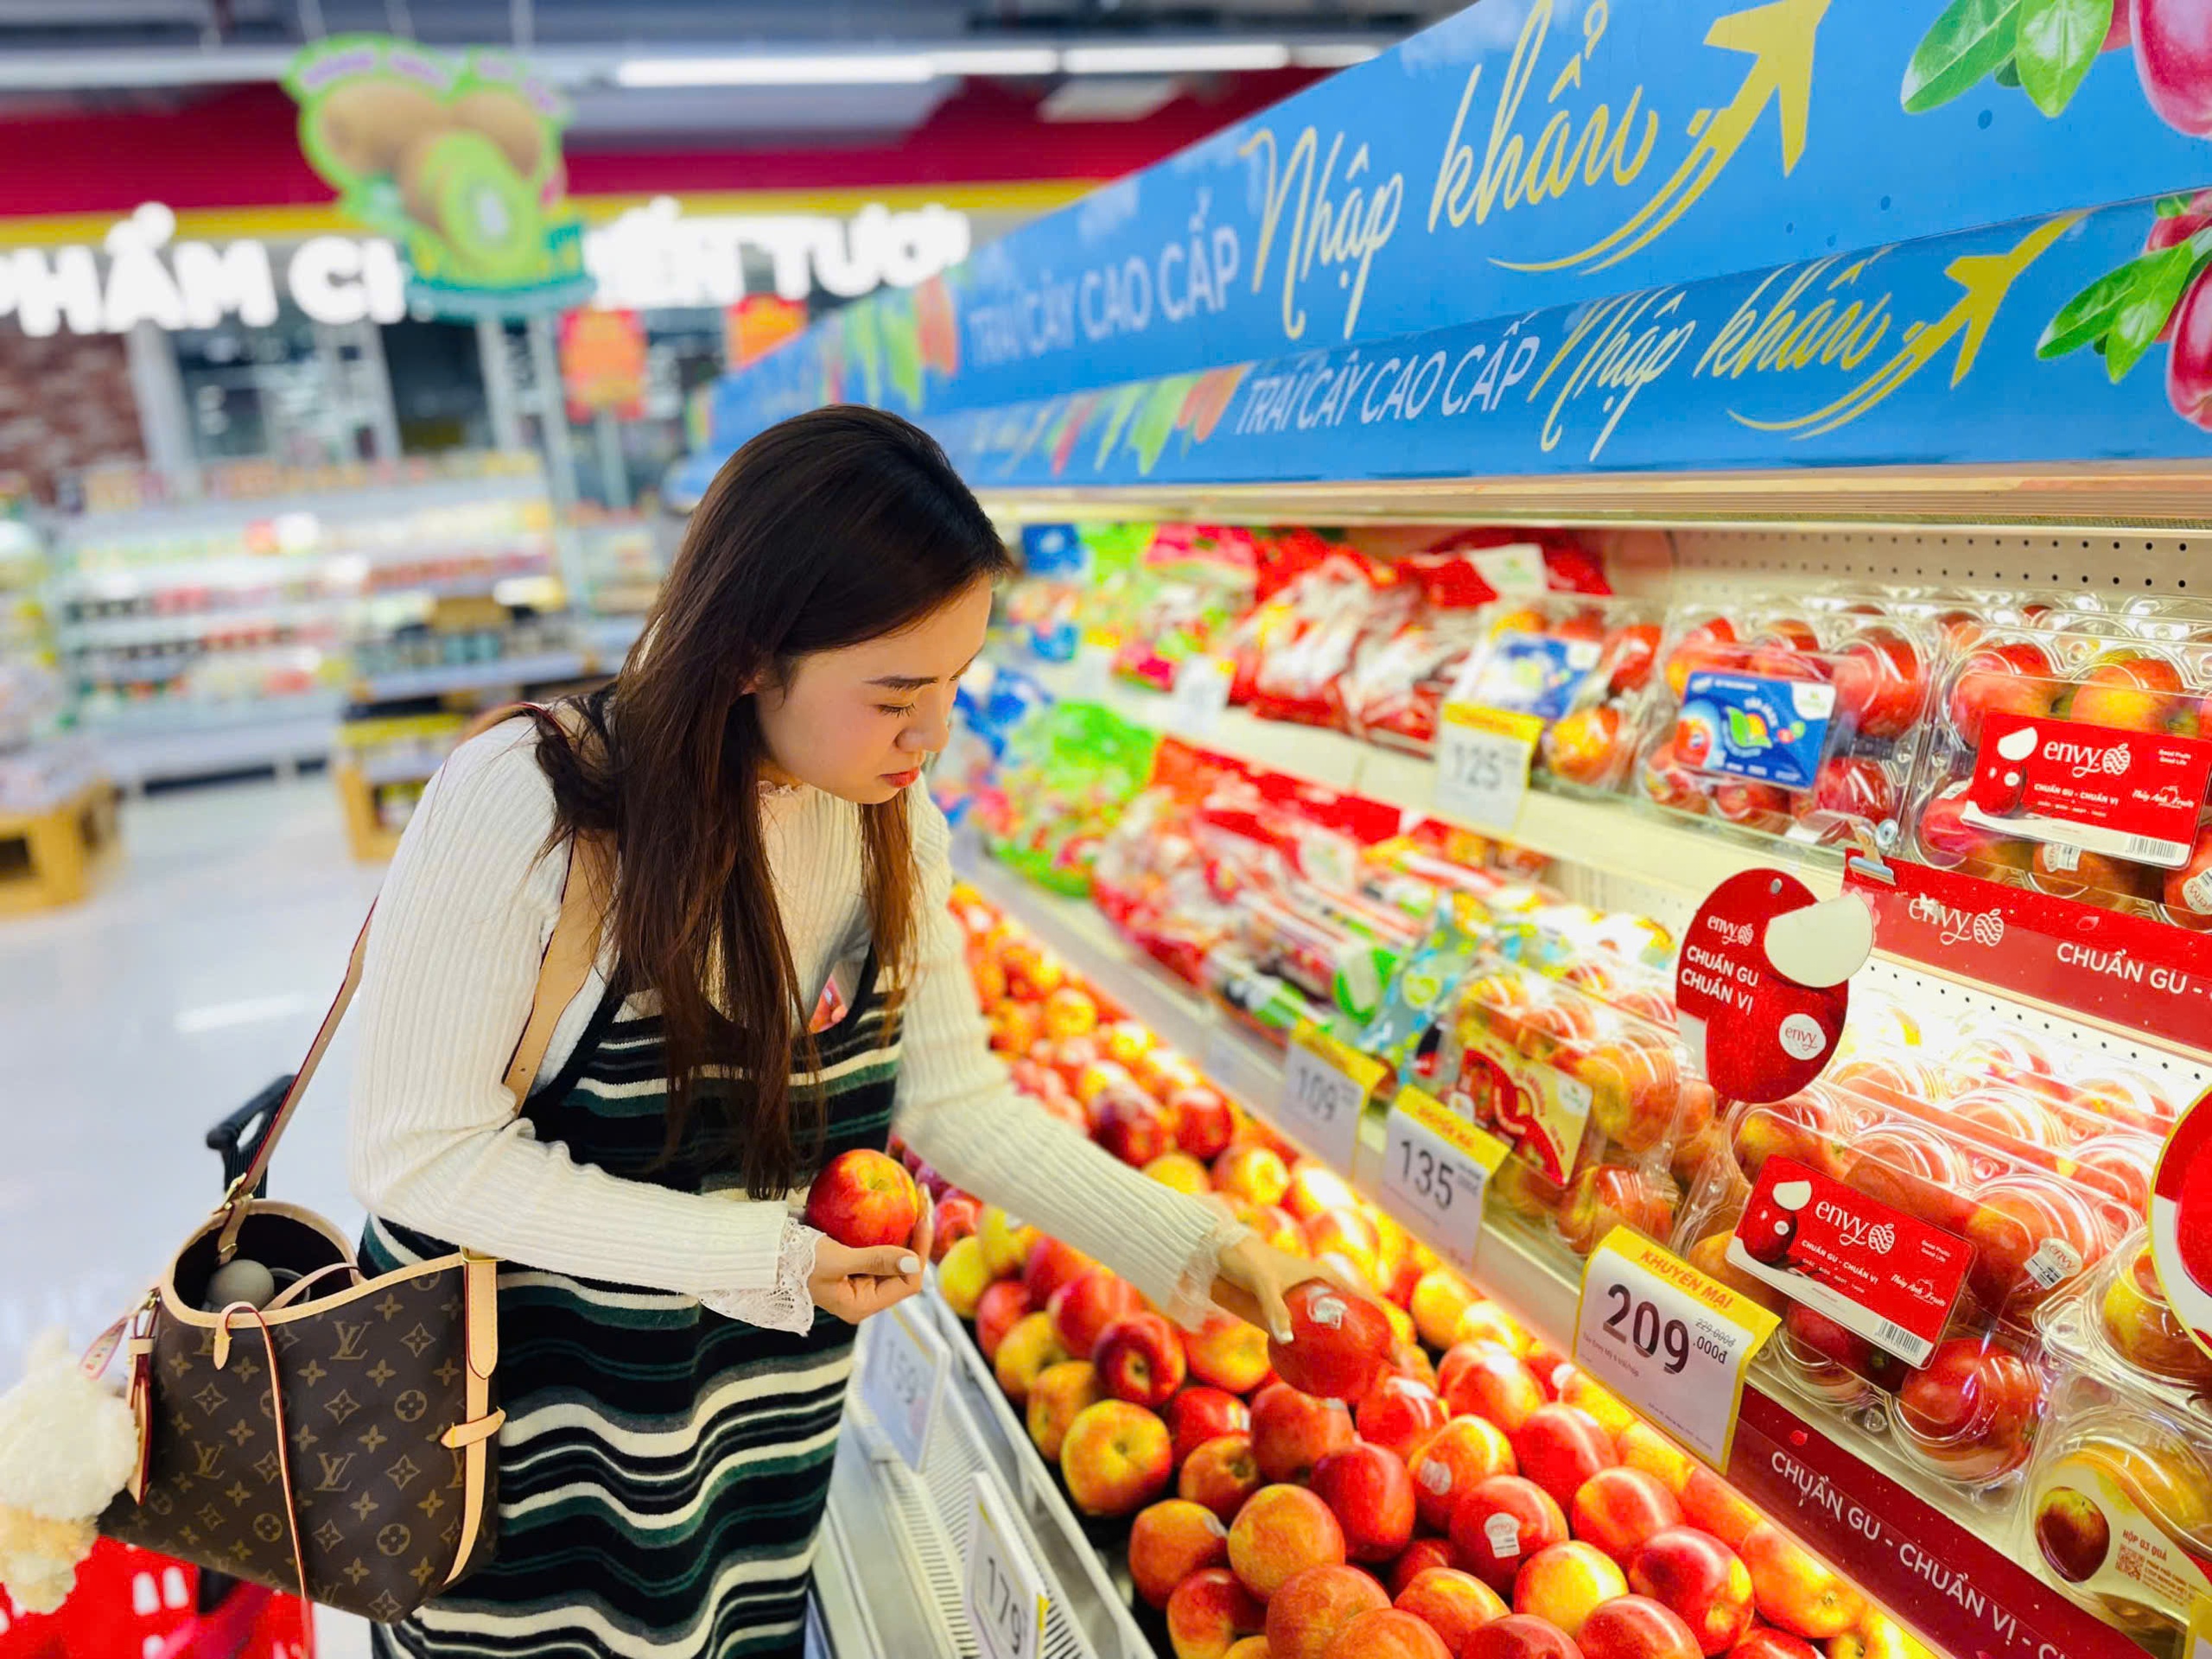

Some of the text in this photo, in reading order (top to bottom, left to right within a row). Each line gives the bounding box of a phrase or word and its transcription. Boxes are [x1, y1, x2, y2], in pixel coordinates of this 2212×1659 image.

[1080, 257, 1154, 340] CAO
[1159, 187, 1240, 321] CẤP
[1236, 126, 1403, 340] Nhập
[1427, 0, 1658, 233] khẩu
[1297, 349, 1374, 429] CÂY
[1361, 350, 1447, 424] CAO
[1441, 311, 1541, 416] CẤP
[1527, 283, 1697, 462] Nhập
[1455, 743, 1502, 791] 125
[2044, 740, 2101, 778] envy
[2062, 788, 2074, 798] GU
[1707, 915, 1738, 945] envy
[1736, 965, 1760, 988] GU
[2056, 942, 2144, 983] CHUẨN
[2149, 968, 2188, 995] GU
[1784, 1026, 1818, 1051] envy
[1300, 1065, 1337, 1121] 109
[1400, 1140, 1453, 1210] 135
[1815, 1200, 1871, 1247] envy
[1827, 1252, 1840, 1263] GU
[1602, 1283, 1690, 1376] 209
[1692, 1335, 1728, 1365] .000đ
[1847, 1506, 1882, 1541] GU
[1898, 1543, 1986, 1618] CHUẨN
[1993, 1605, 2018, 1646] VỊ
